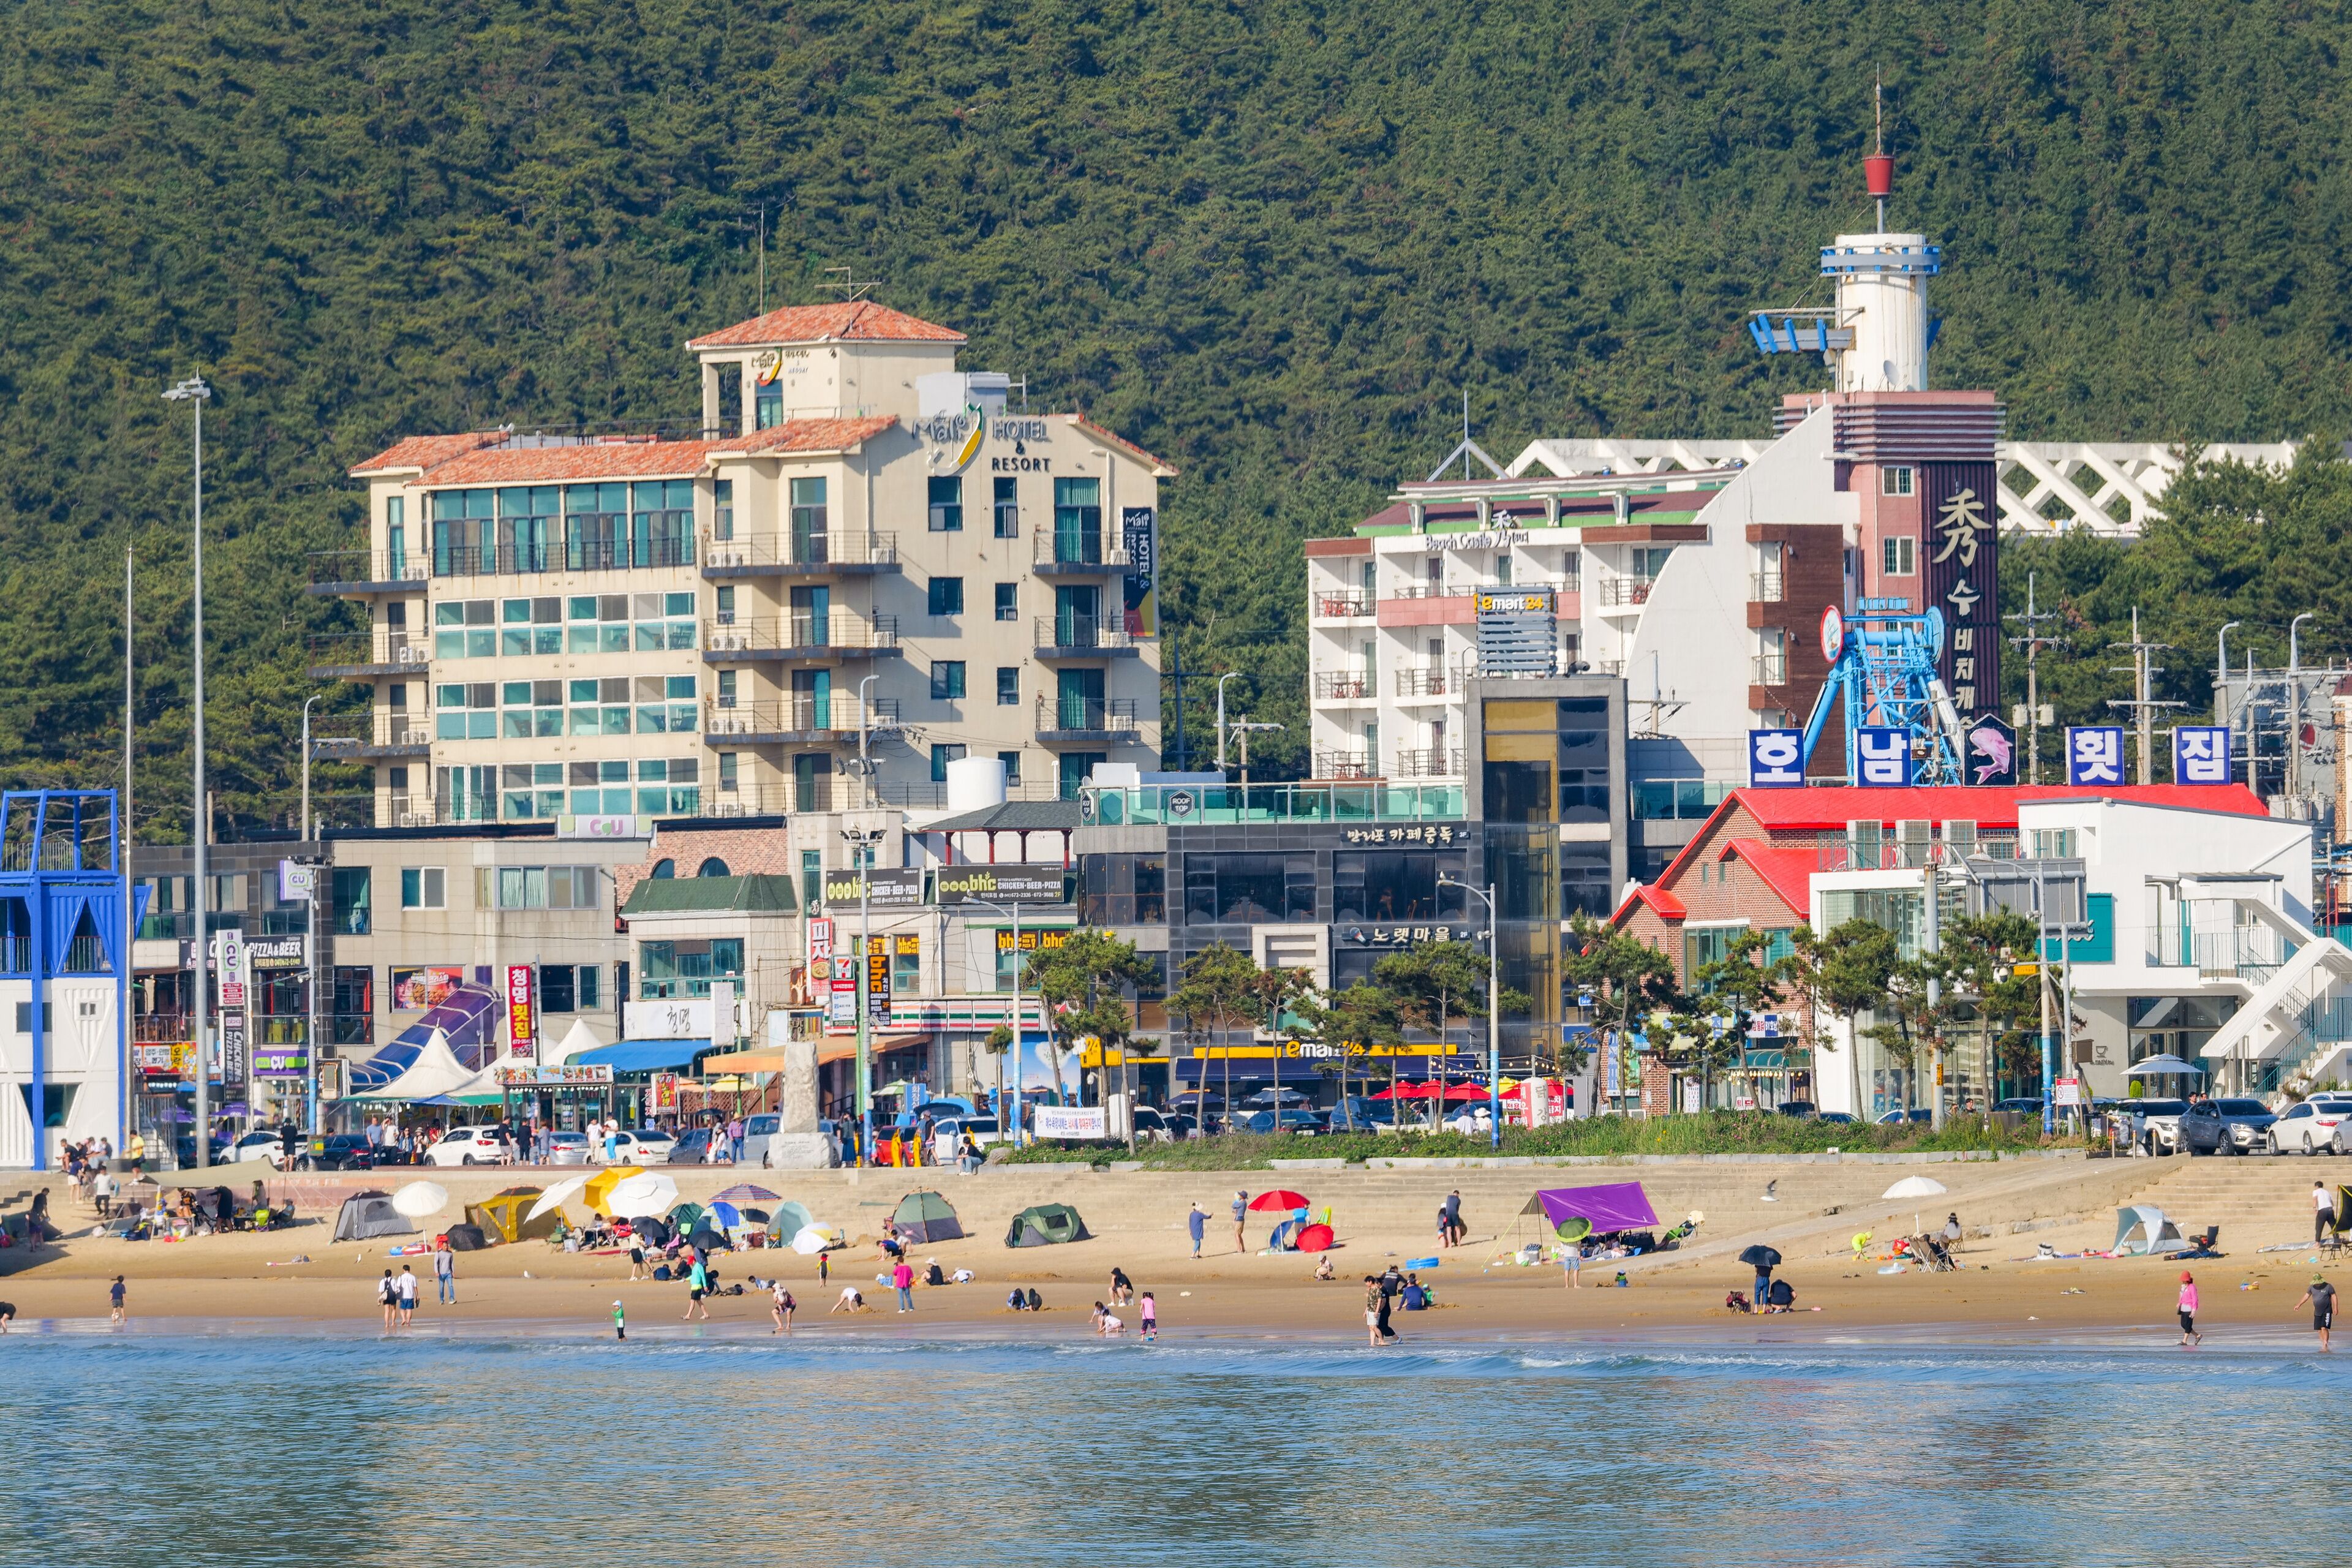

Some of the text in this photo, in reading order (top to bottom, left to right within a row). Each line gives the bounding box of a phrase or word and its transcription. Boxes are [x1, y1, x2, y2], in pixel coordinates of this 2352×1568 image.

[992, 420, 1047, 439] HOTEL
[1016, 441, 1025, 454] &
[992, 458, 1052, 471] RESORT
[1932, 488, 1992, 568] 秀
[1425, 534, 1457, 550] Beach
[1460, 532, 1491, 548] Castle
[1139, 534, 1149, 576] HOTEL
[1348, 828, 1385, 843] 만리포
[1389, 826, 1453, 844] 카페중독
[292, 875, 304, 883] CU
[970, 872, 996, 891] bhc
[812, 921, 831, 961] 피자
[226, 945, 236, 966] CU
[870, 956, 886, 992] bhc
[270, 1055, 285, 1070] CU
